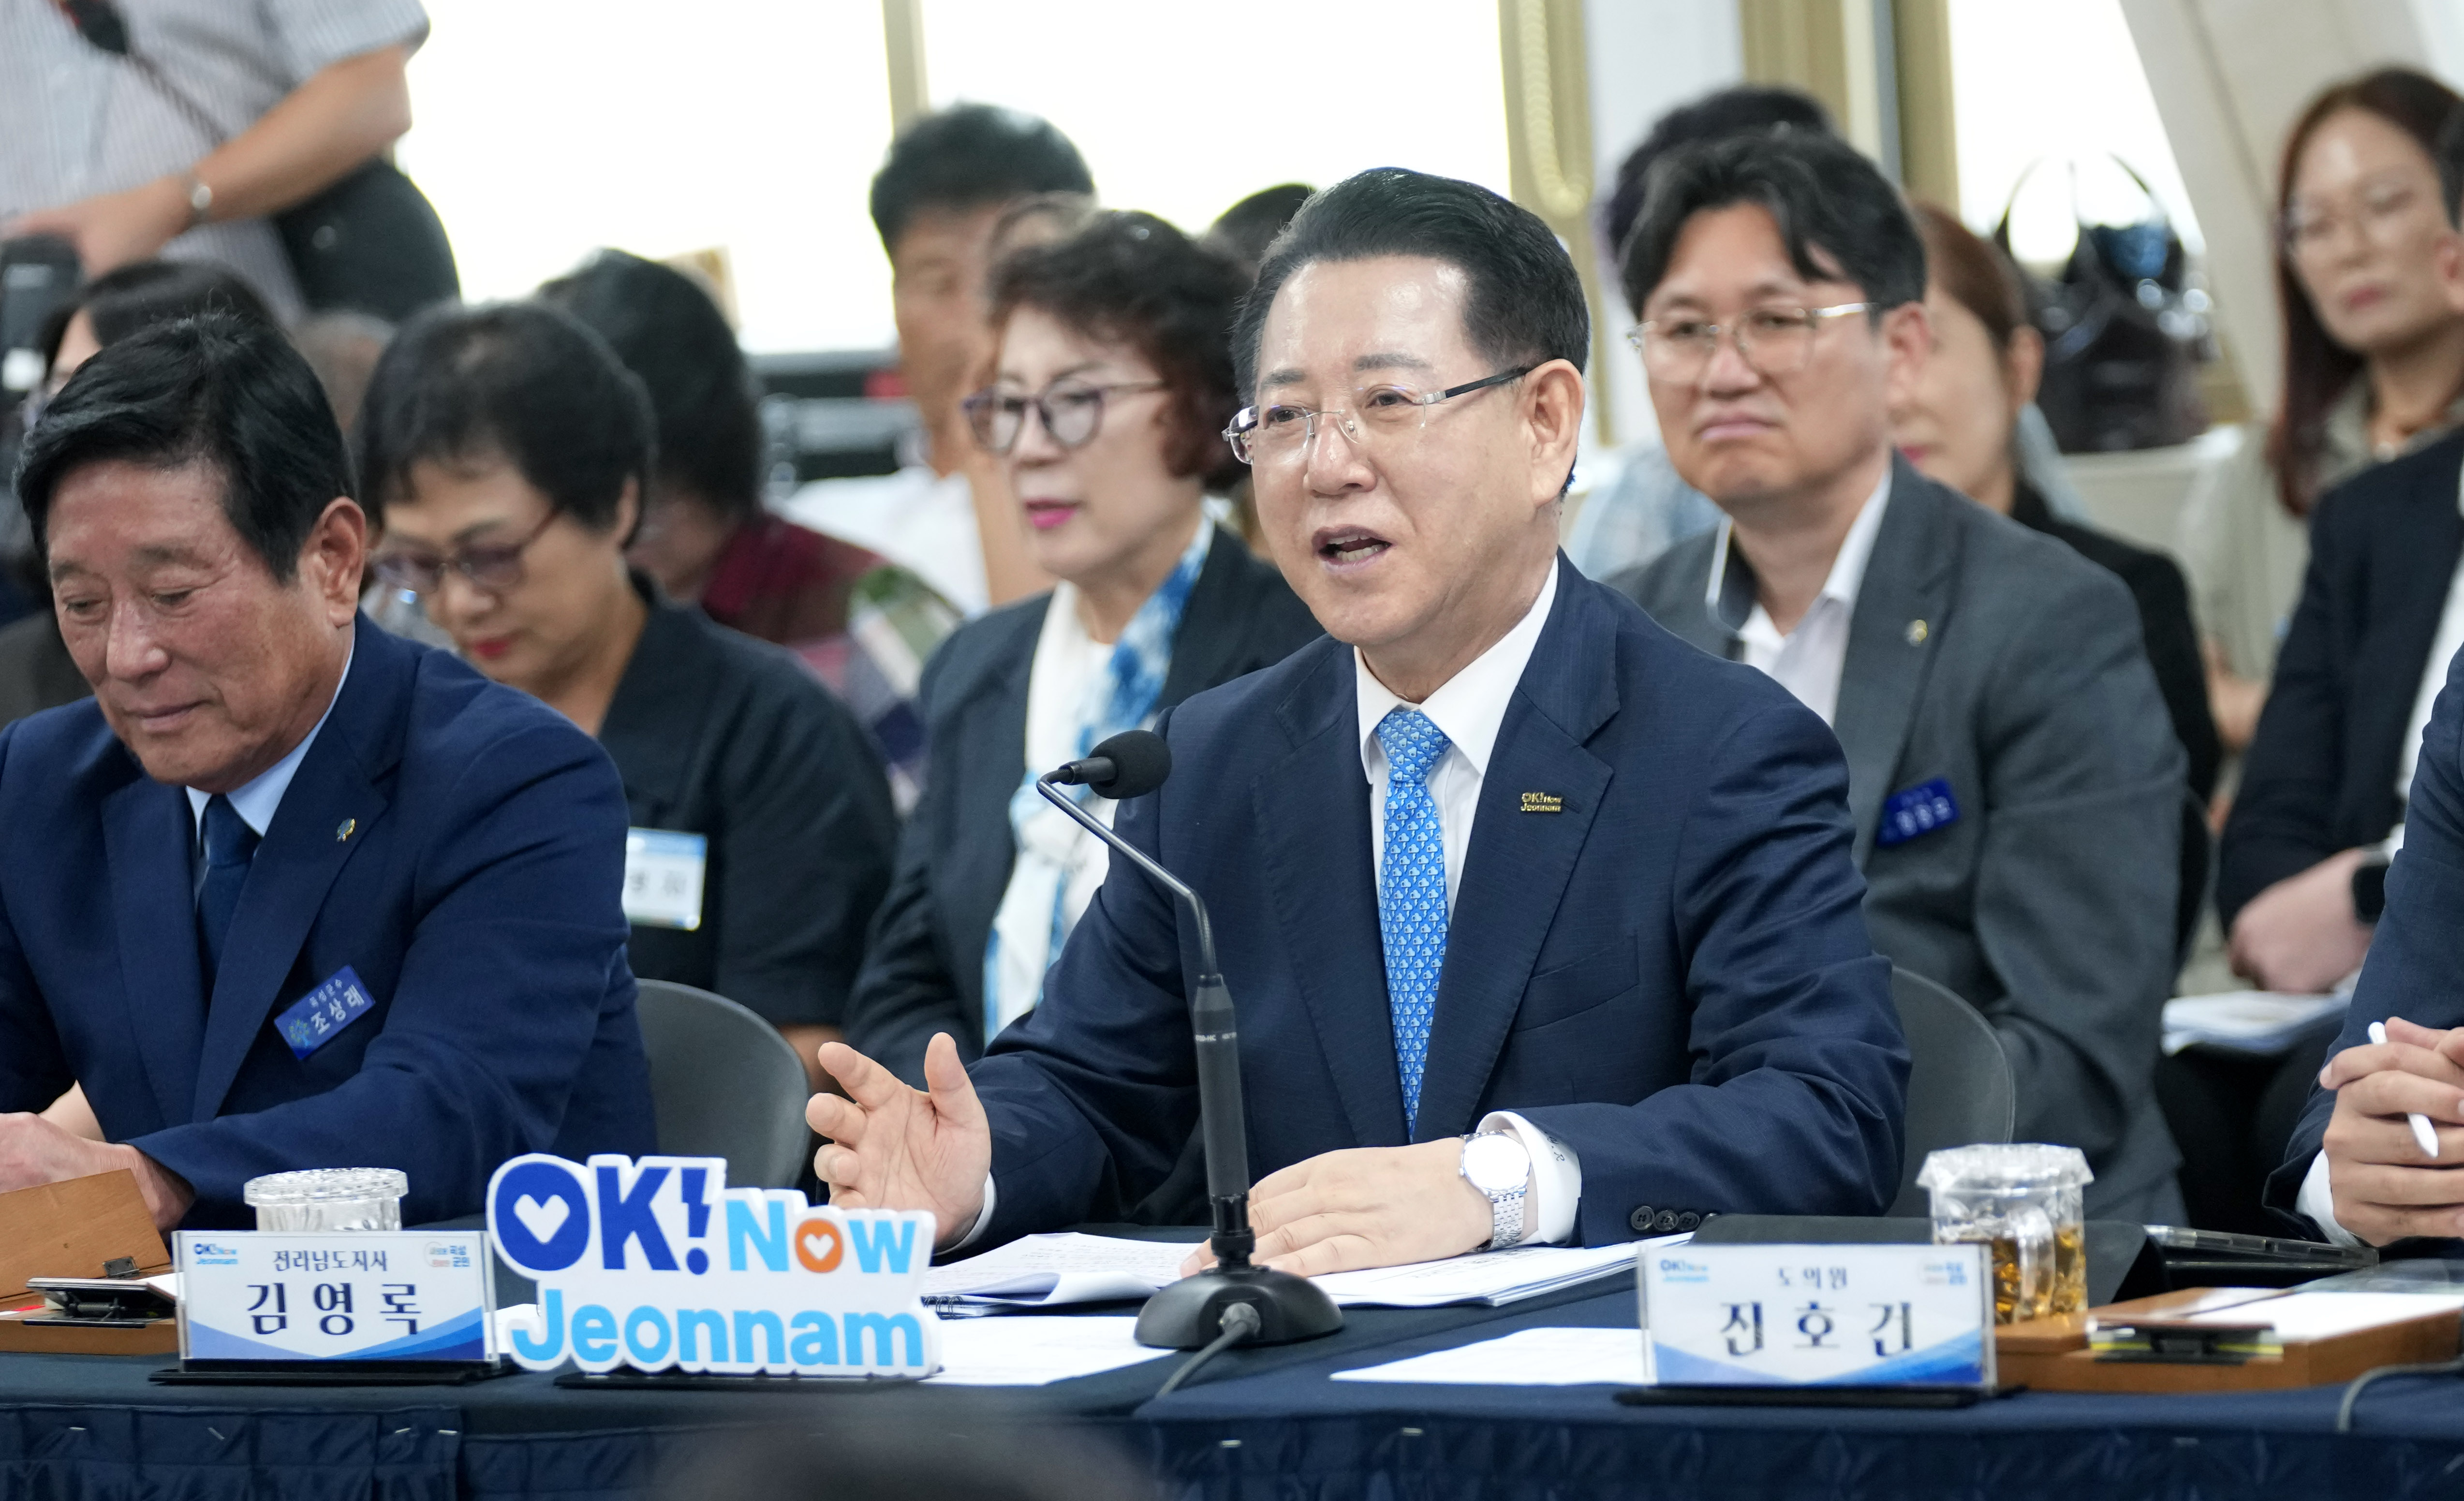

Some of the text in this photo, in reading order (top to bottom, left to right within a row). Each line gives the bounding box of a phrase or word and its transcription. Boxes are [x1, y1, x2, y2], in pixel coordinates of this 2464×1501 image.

[1520, 803, 1561, 812] Jeonnam
[310, 985, 365, 1035] 조상래
[495, 1162, 712, 1275] OK!
[273, 1250, 388, 1272] 전라남도지사
[247, 1282, 422, 1336] 김영록
[512, 1289, 924, 1368] Jeonnam
